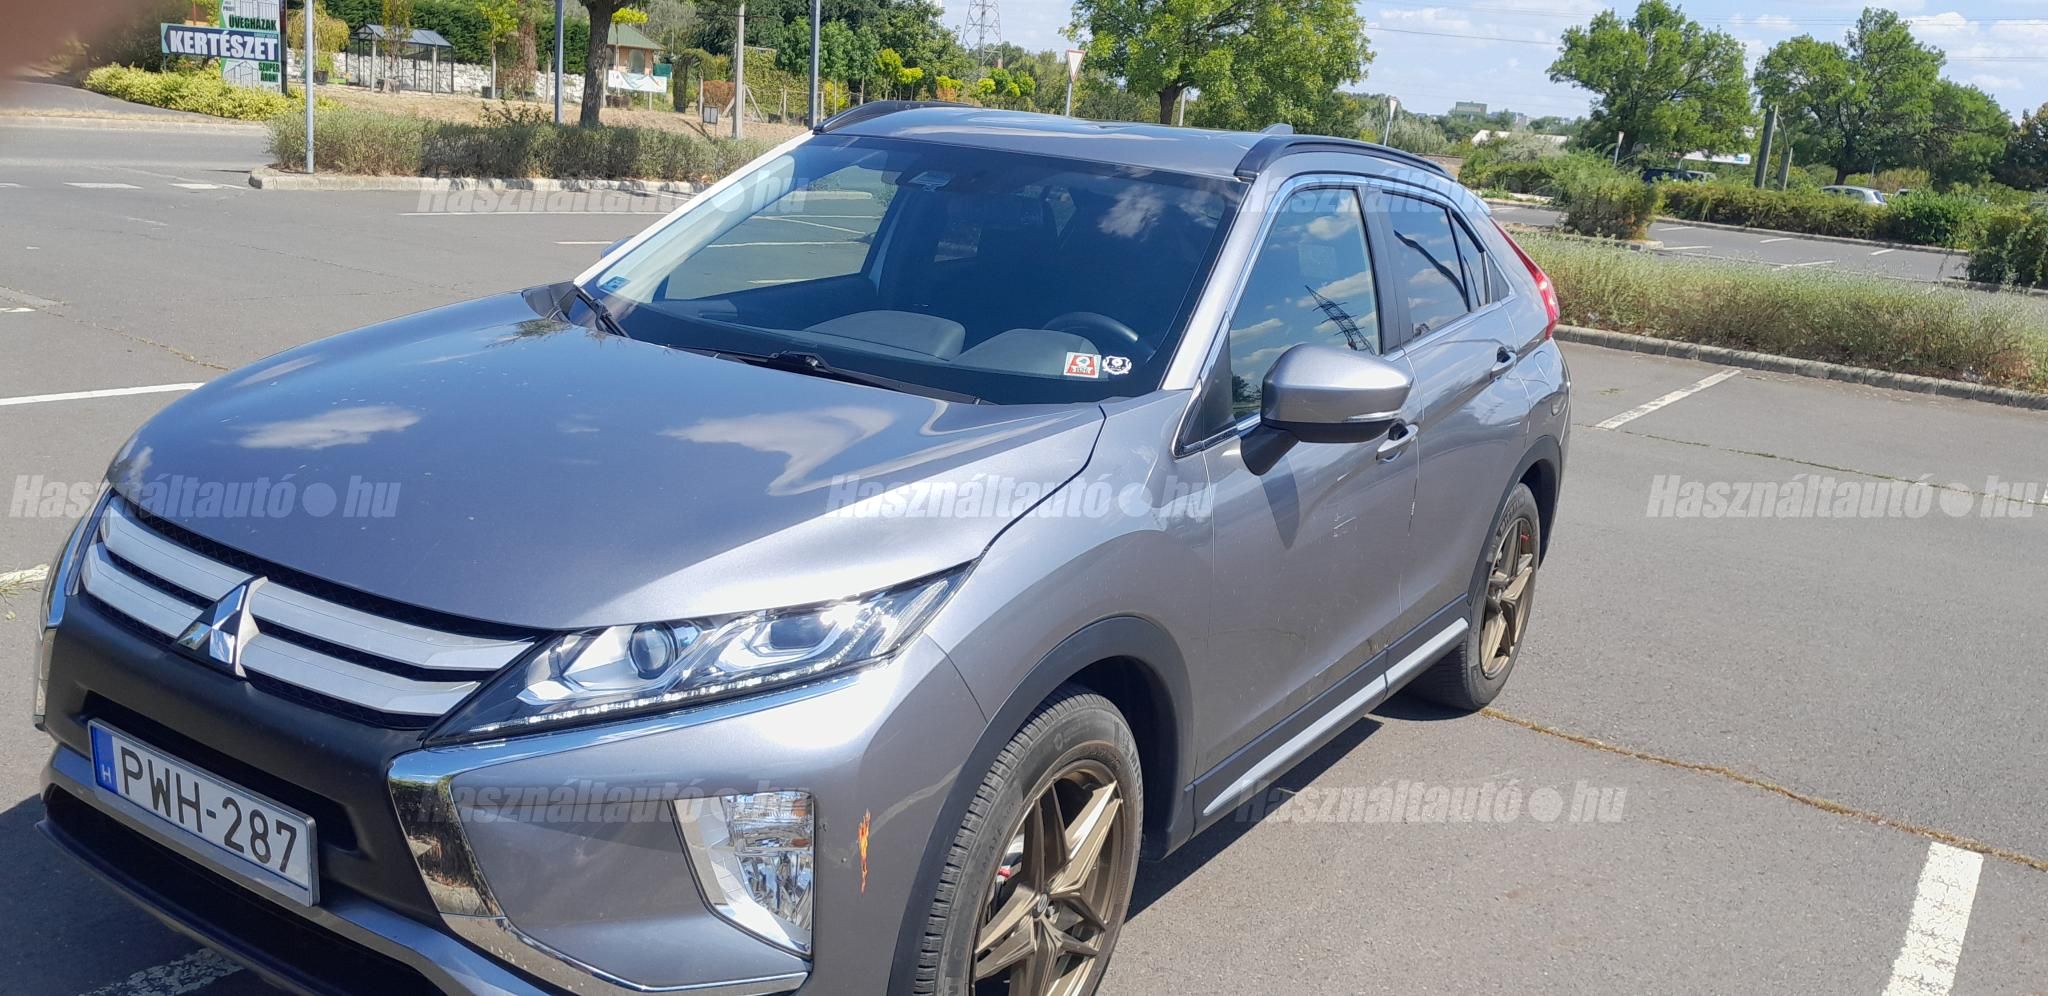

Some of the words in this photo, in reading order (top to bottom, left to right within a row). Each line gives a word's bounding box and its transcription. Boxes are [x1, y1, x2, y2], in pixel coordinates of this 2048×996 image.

[169, 30, 278, 61] KERTÉSZET
[101, 767, 112, 784] H
[120, 746, 297, 873] PWH-287
